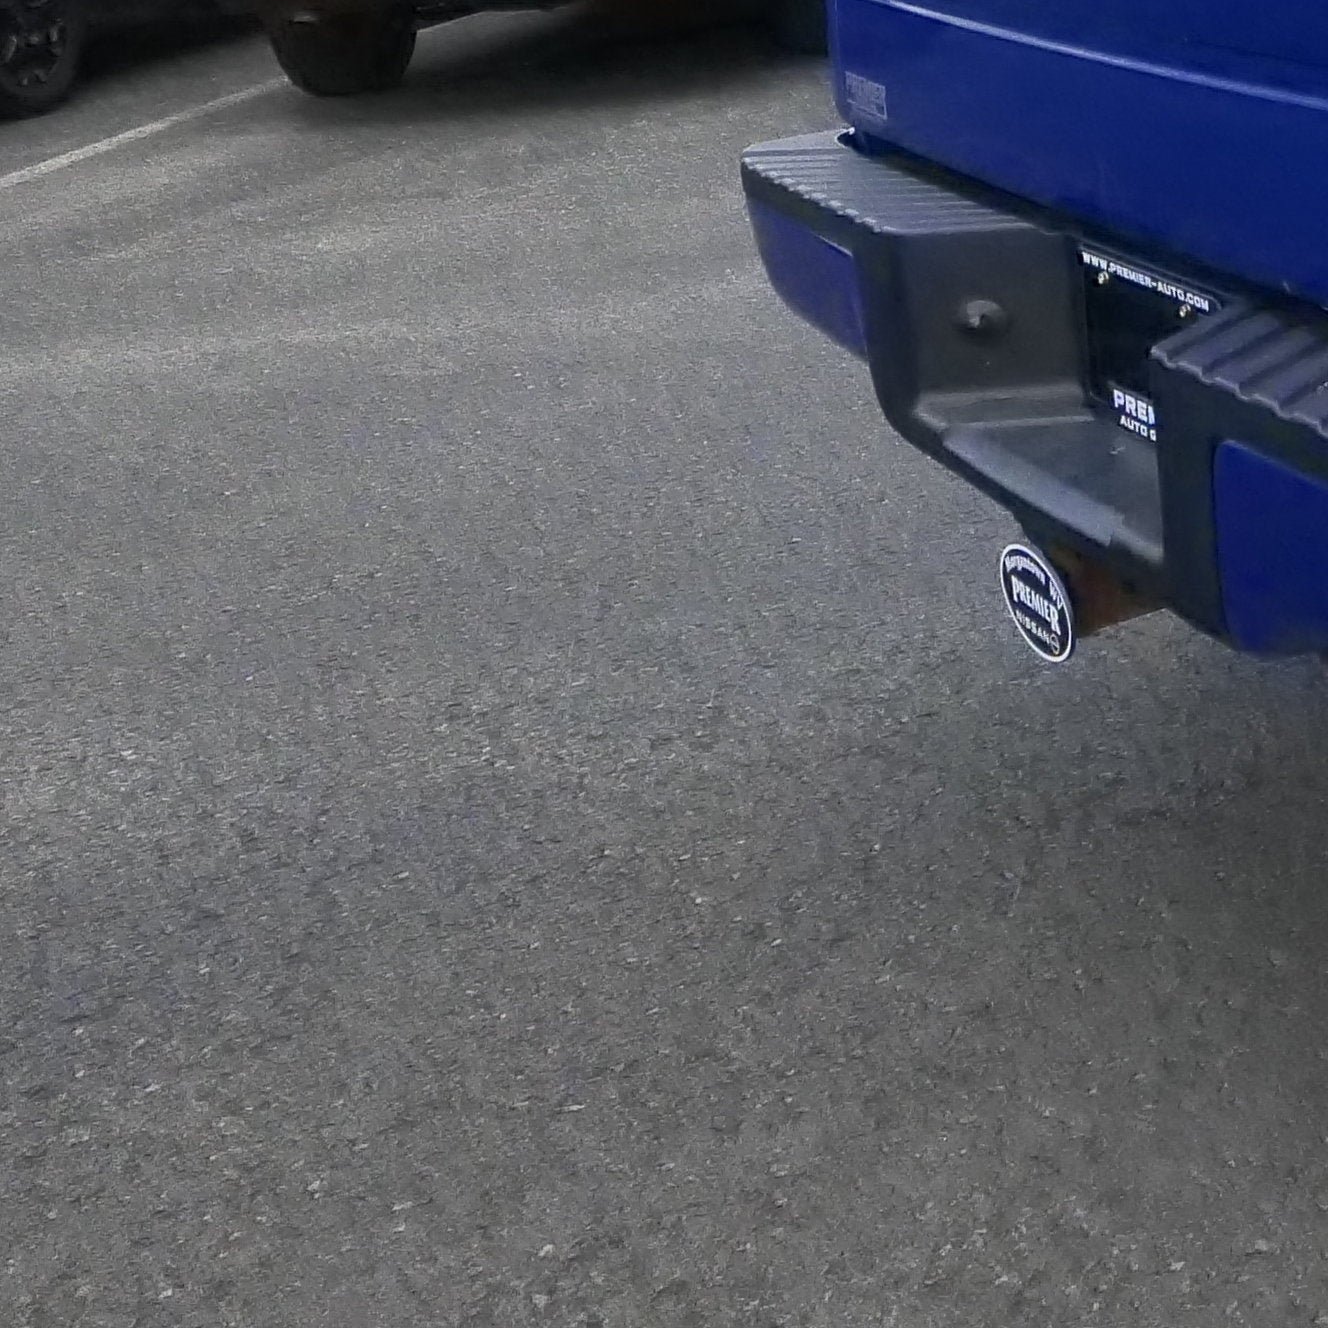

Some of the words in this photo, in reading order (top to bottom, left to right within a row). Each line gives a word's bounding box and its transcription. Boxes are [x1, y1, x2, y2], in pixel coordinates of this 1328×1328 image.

[1081, 251, 1209, 312] WWW.PREMIER-AUTO.COM
[1120, 415, 1148, 438] AUTO
[1011, 574, 1061, 636] PREMIER
